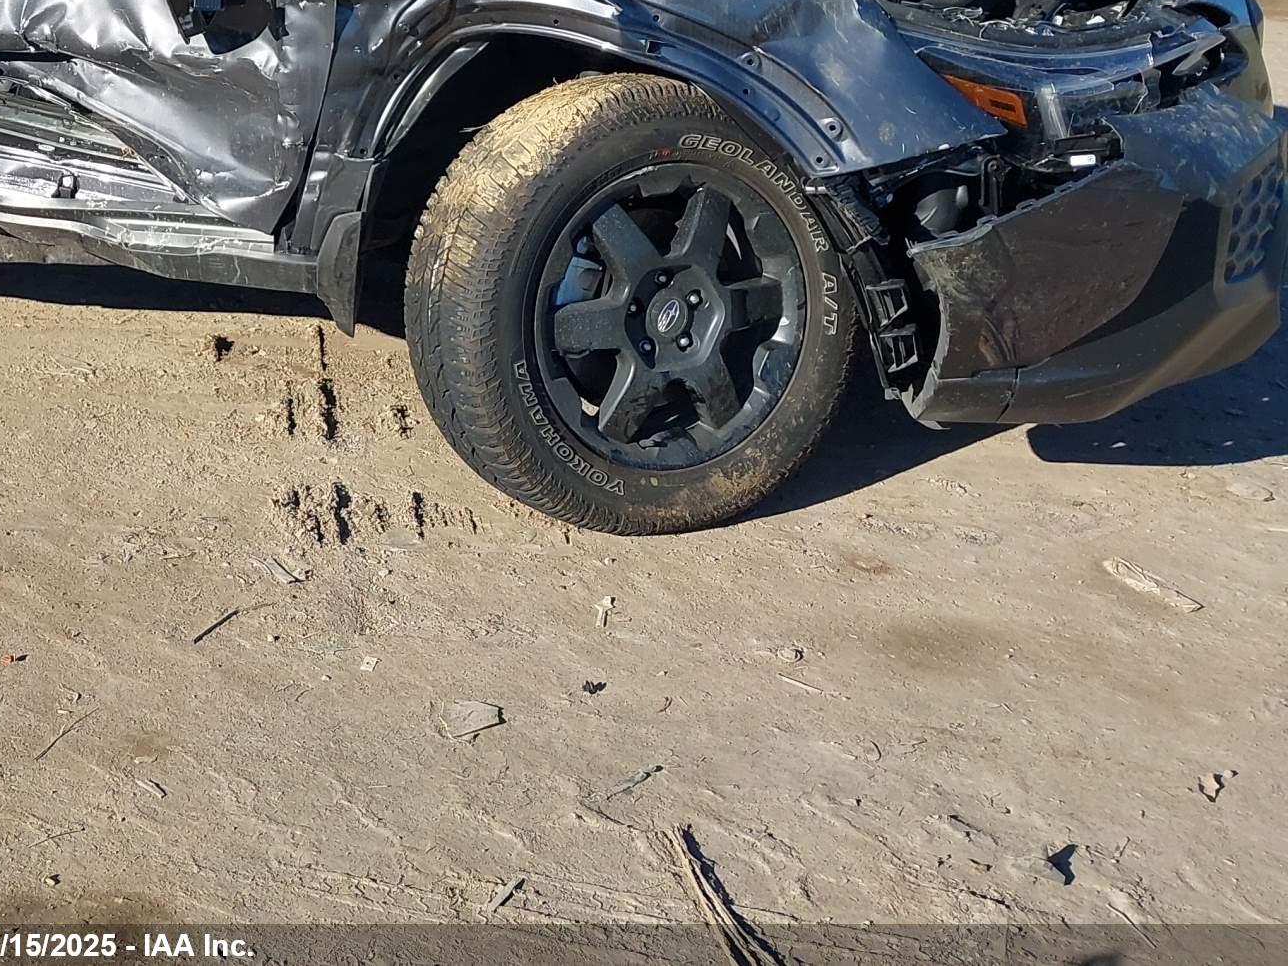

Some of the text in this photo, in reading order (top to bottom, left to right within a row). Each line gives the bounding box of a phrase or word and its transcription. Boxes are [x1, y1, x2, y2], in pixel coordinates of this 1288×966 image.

[679, 134, 839, 336] GEOLANDAR A/T
[513, 359, 626, 496] YOKOHAMA
